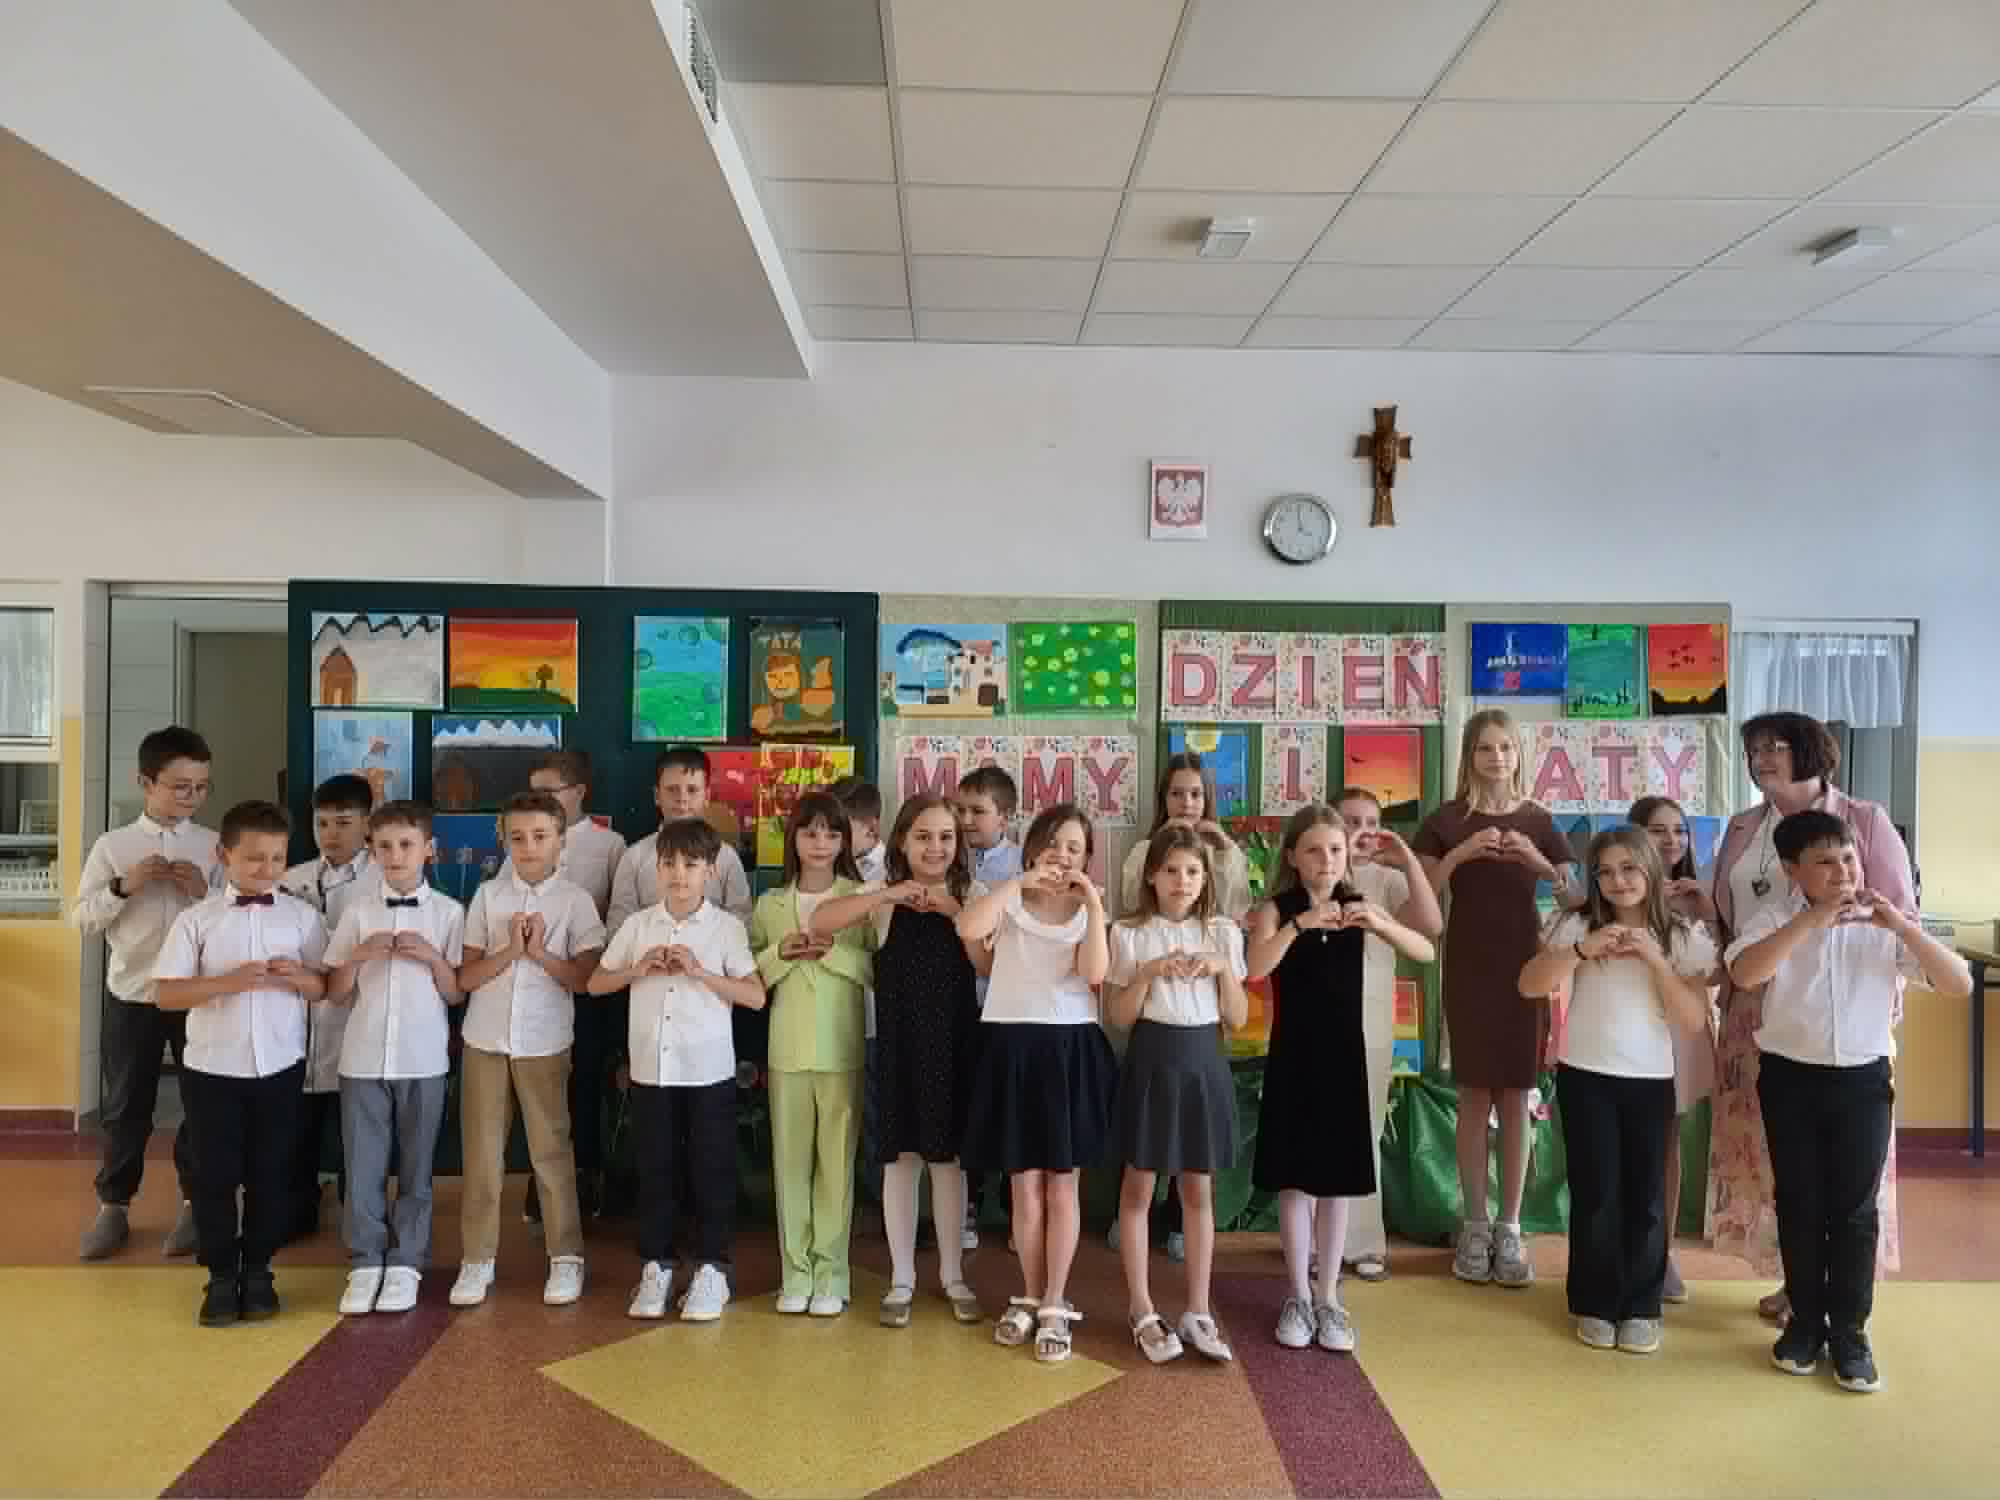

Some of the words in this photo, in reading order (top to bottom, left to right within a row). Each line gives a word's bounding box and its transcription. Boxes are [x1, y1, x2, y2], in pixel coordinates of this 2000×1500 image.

[902, 756, 1128, 811] MMY
[1285, 745, 1303, 800] I
[1532, 746, 1697, 801] ATY
